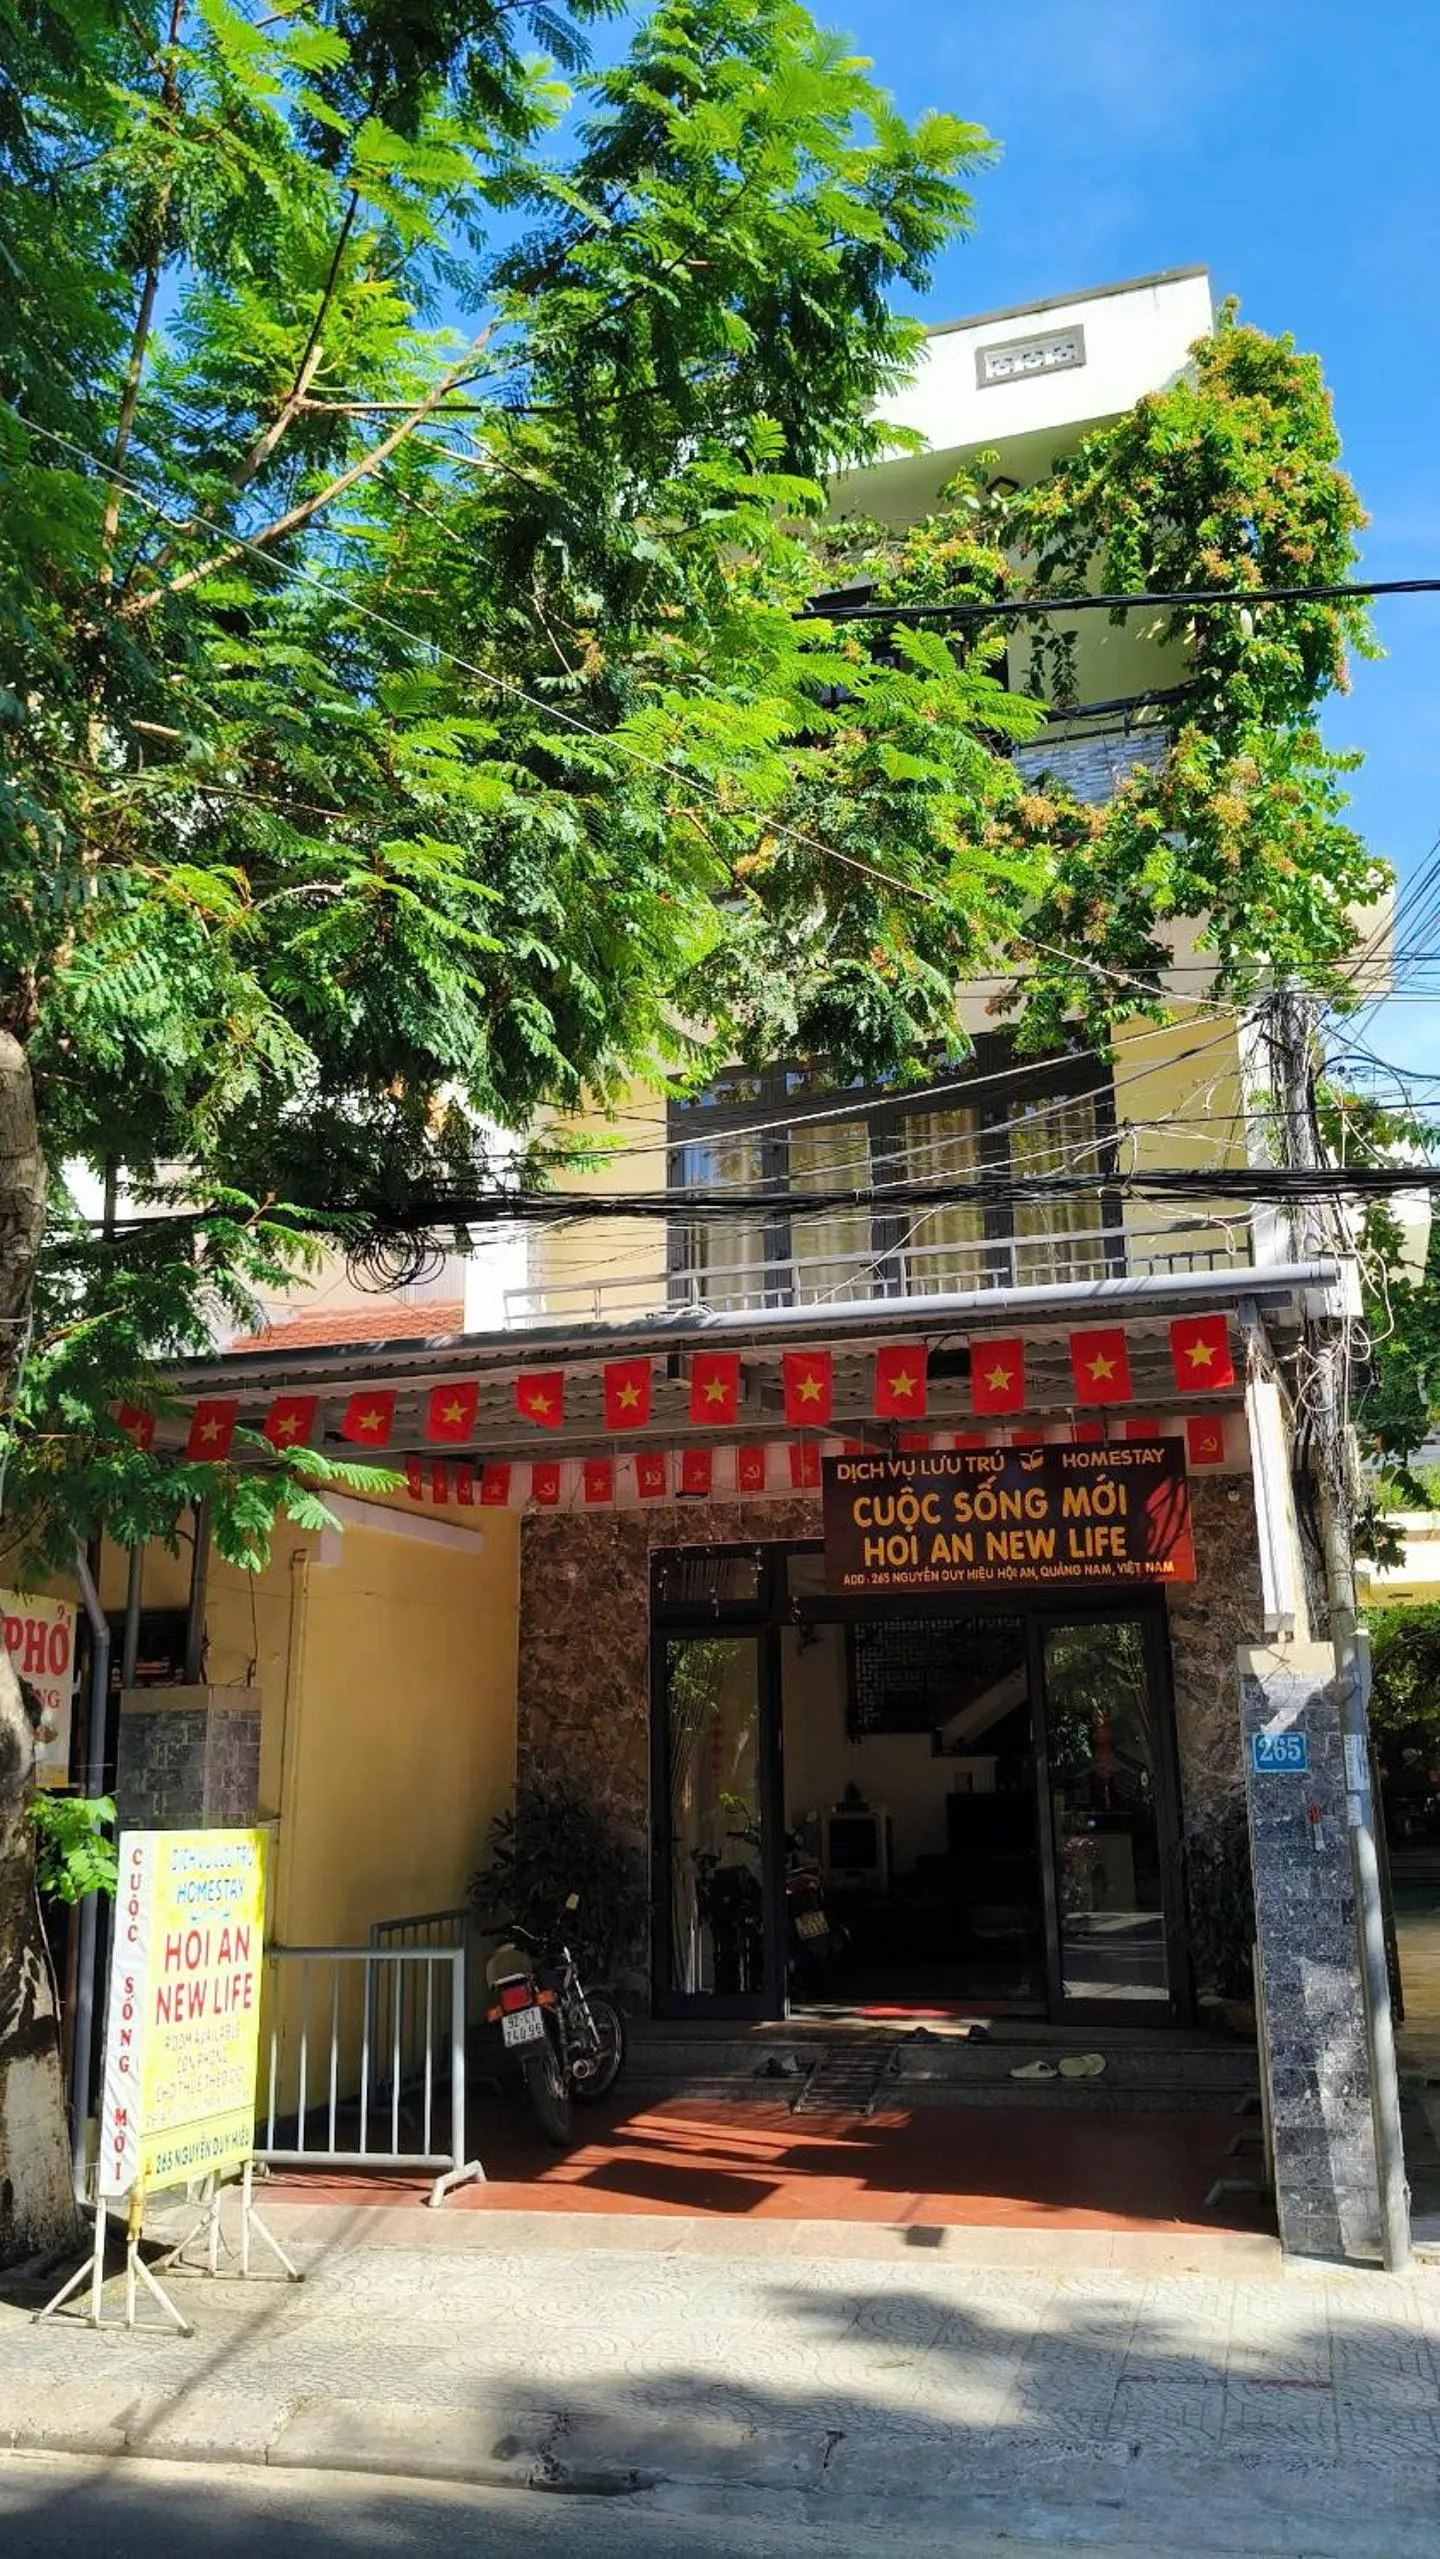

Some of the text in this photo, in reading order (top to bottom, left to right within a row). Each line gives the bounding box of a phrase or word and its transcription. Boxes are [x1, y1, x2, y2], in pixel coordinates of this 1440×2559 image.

[837, 1448, 1166, 1484] DỊCH VỤ LƯU TRÚ HOMESTAY
[853, 1473, 1128, 1533] CUỘC SỐNG MỚI
[931, 1531, 974, 1564] AN
[986, 1527, 1056, 1561] NEW
[1068, 1525, 1127, 1559] LIFE
[872, 1571, 890, 1584] 265
[941, 1569, 964, 1582] DUY
[1145, 1560, 1175, 1574] NAM
[1258, 1736, 1301, 1762] 265
[127, 1848, 143, 1942] CUỘC
[177, 1878, 246, 1904] HOMESTAY
[165, 1924, 250, 1972] HOI AN
[156, 1972, 253, 2026] NEW LIFE
[119, 1976, 135, 2073] SỐNG
[156, 2151, 174, 2175] 265
